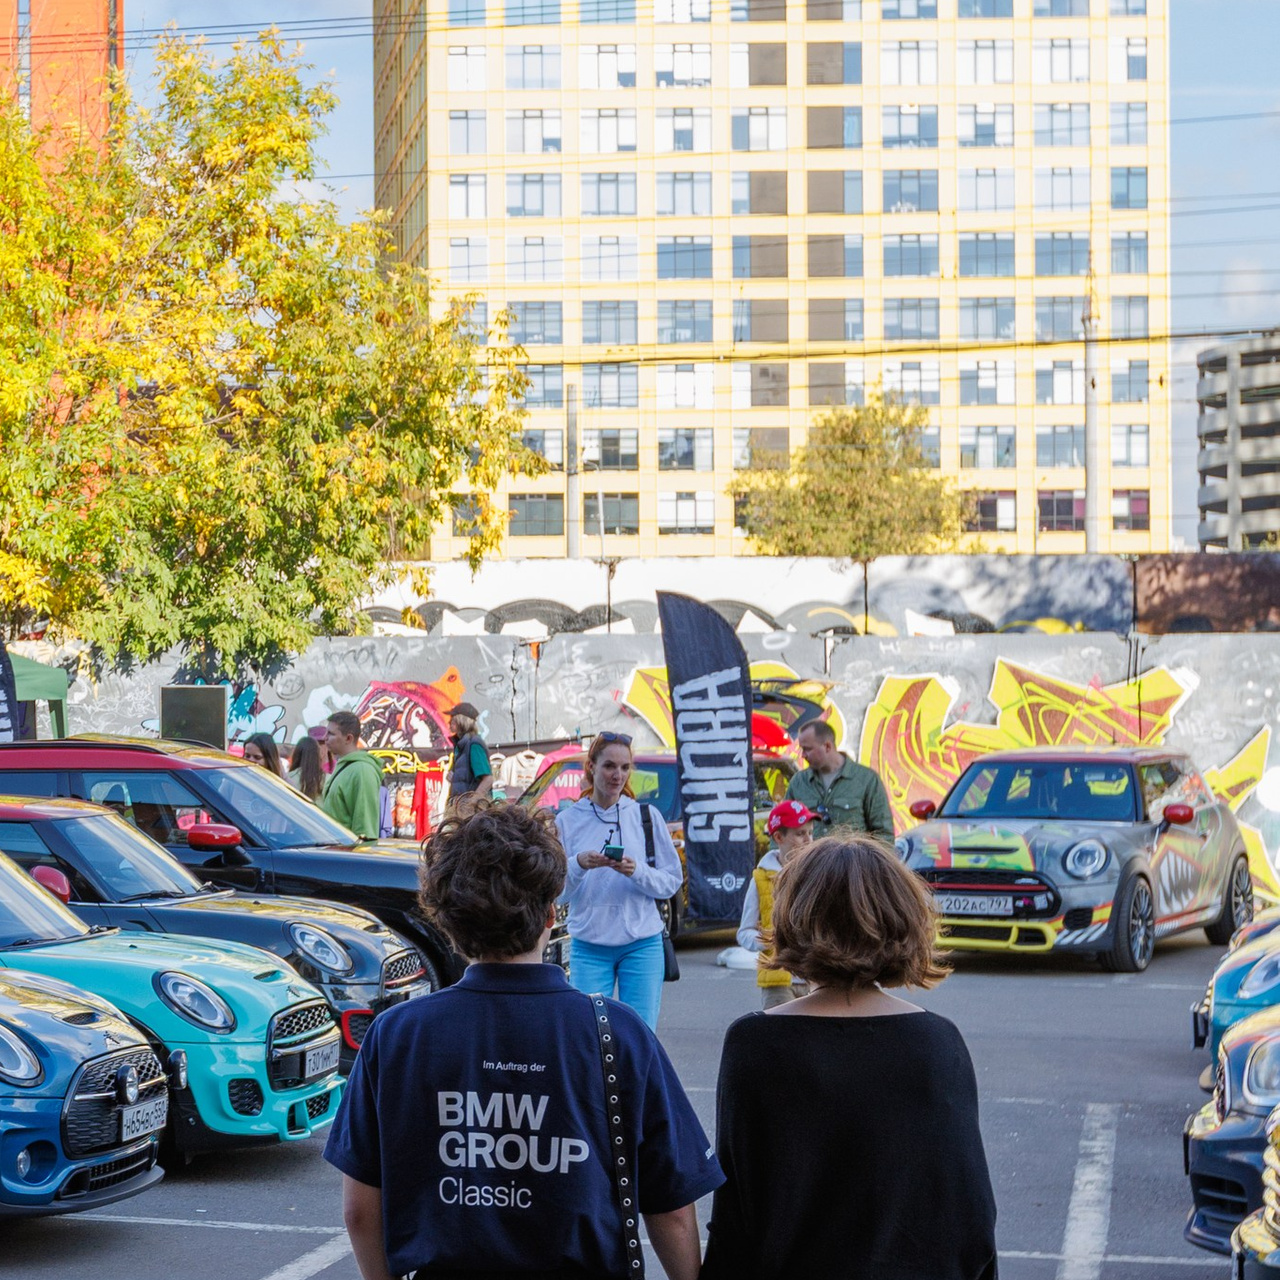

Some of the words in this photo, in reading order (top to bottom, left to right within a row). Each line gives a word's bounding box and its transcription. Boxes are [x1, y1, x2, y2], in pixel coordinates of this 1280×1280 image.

[673, 666, 751, 842] SHQRA
[483, 1060, 495, 1070] Im
[495, 1061, 528, 1073] Auftrag
[530, 1063, 546, 1072] der
[437, 1091, 550, 1130] BMW
[438, 1131, 590, 1174] GROUP
[439, 1176, 532, 1209] Classic
